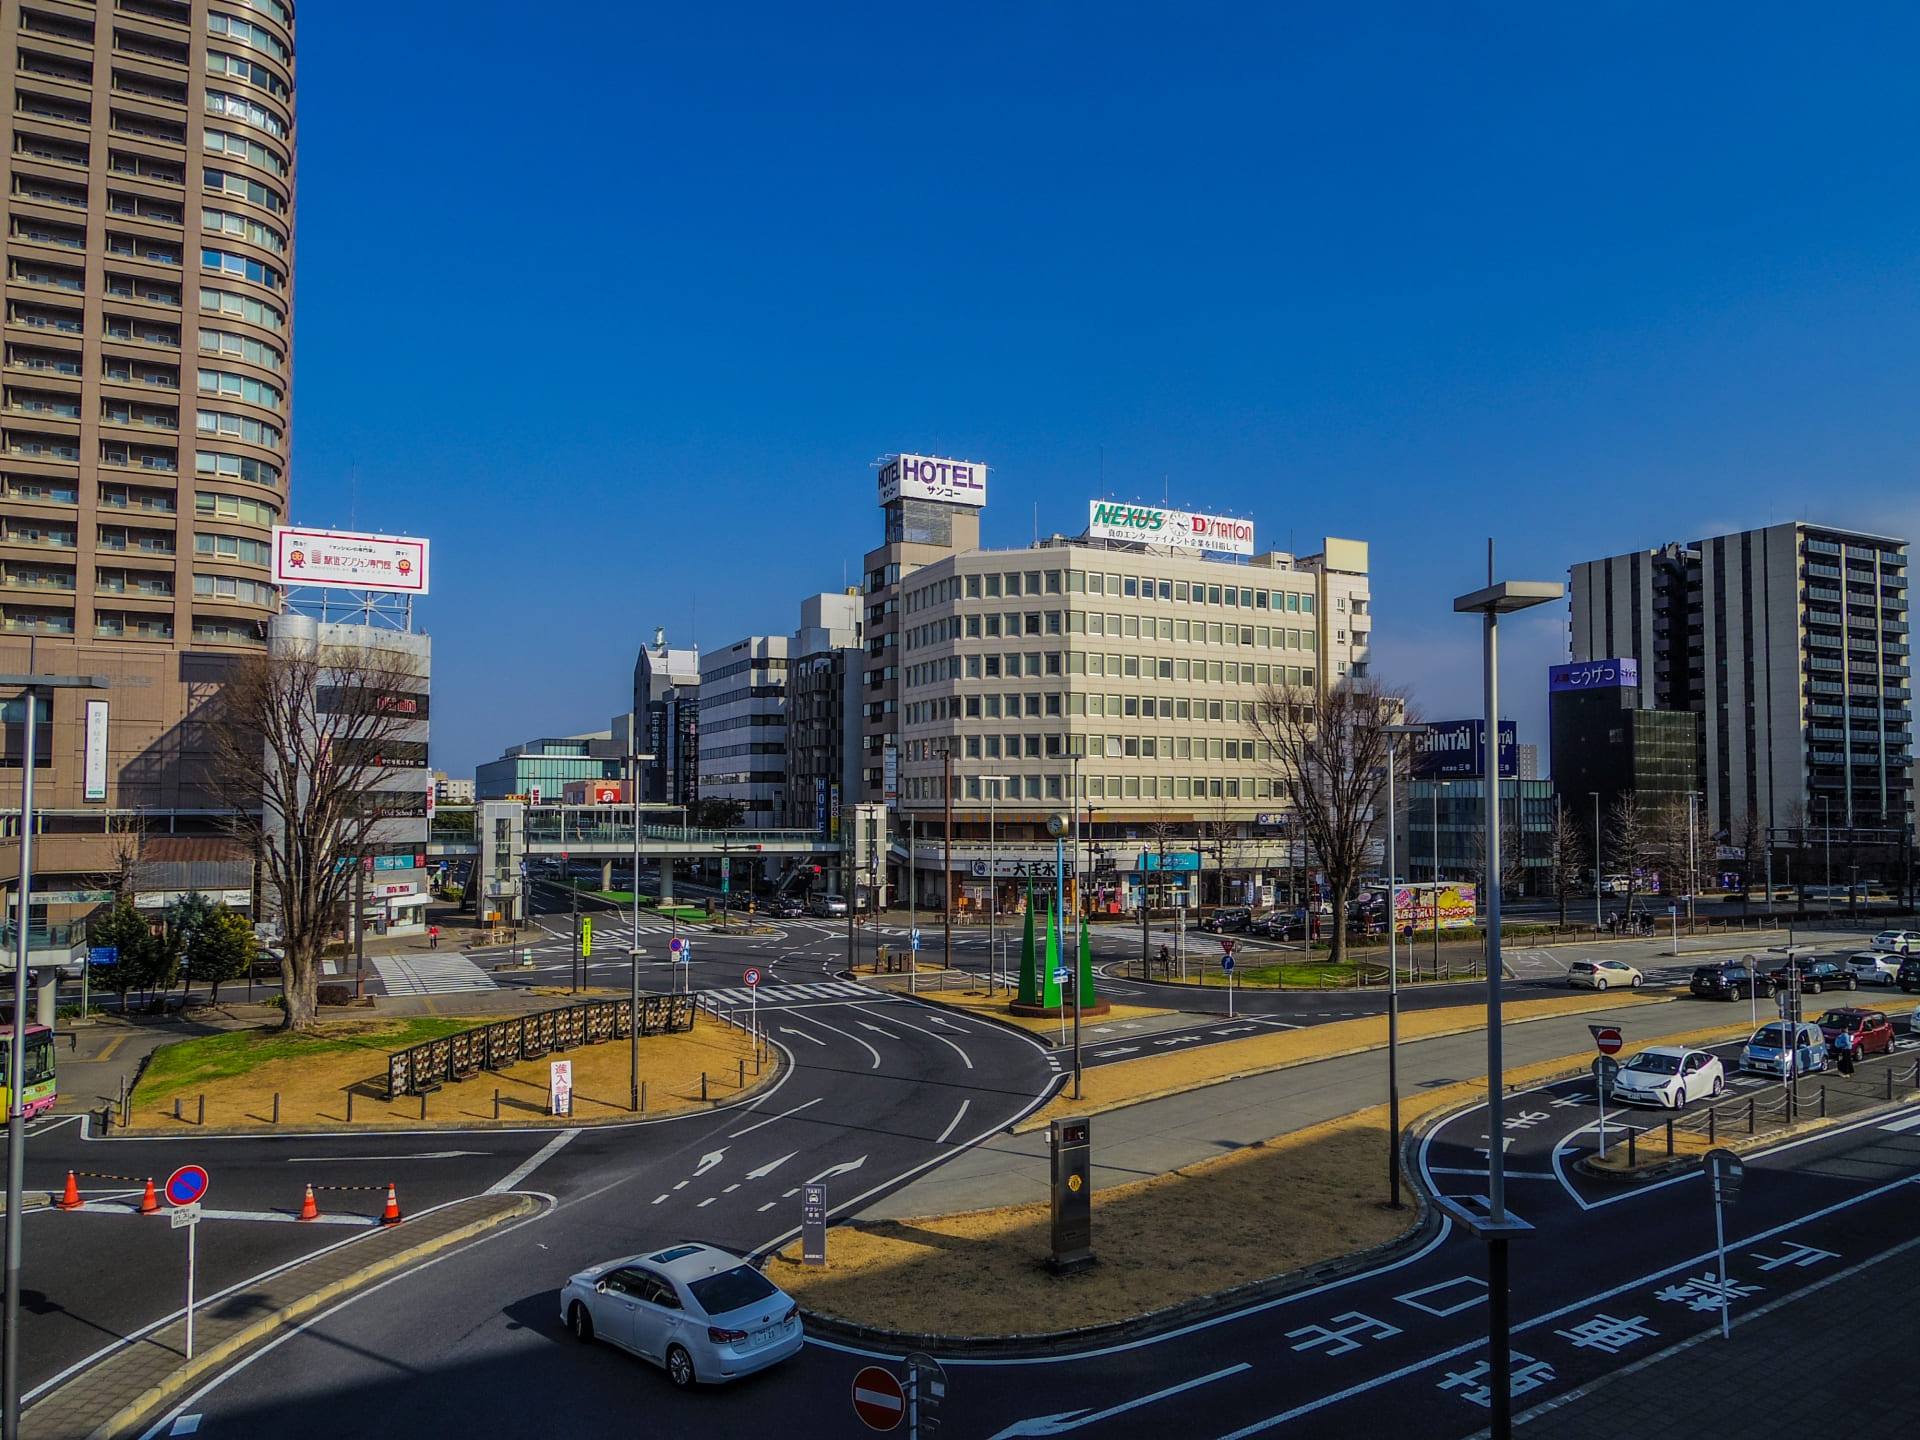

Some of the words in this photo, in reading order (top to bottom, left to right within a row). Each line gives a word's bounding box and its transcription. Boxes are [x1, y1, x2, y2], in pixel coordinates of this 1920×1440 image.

[879, 461, 900, 490] HOTEL
[903, 458, 984, 490] HOTEL
[926, 485, 961, 498] サンコー
[1093, 503, 1165, 530] NEXUS
[1570, 665, 1615, 686] こうげつ
[1415, 726, 1471, 752] CHINTAI
